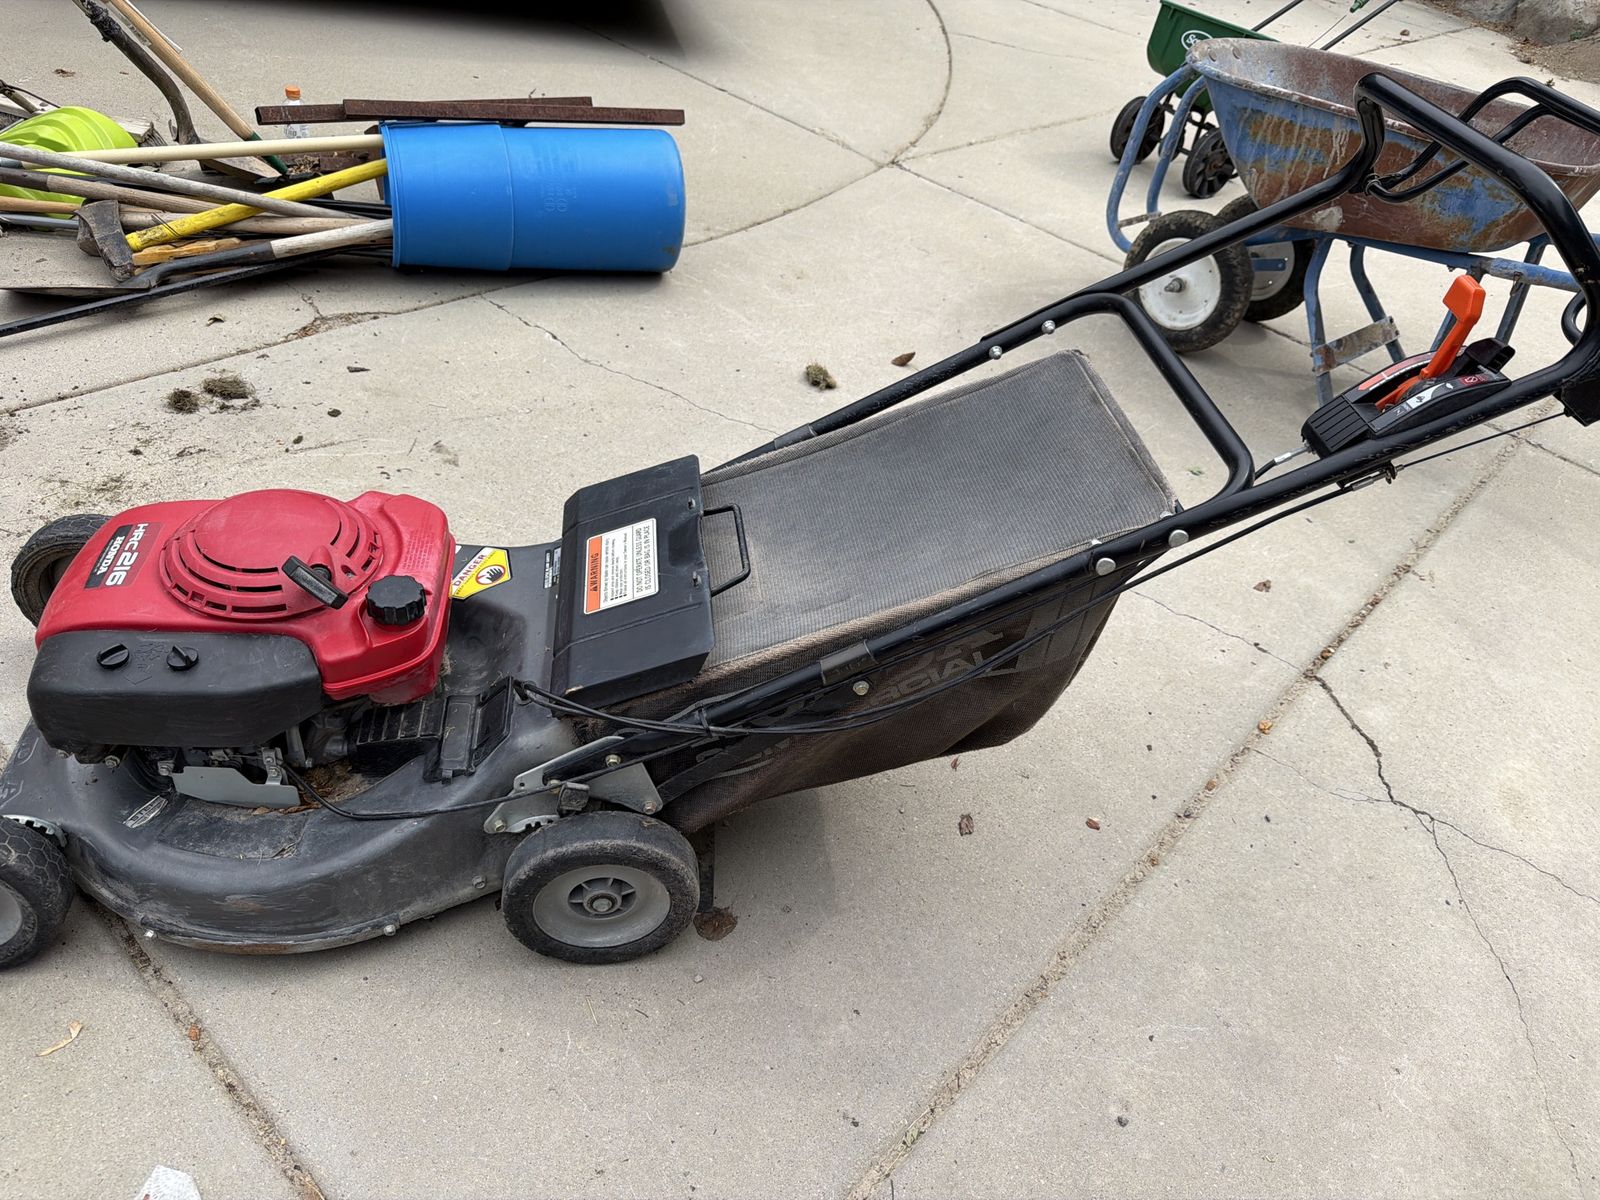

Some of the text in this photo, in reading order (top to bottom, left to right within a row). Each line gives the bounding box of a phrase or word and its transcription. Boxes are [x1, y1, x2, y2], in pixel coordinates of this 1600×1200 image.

[97, 536, 125, 576] HONDA
[453, 554, 486, 587] DANGER
[590, 552, 599, 587] WARNING
